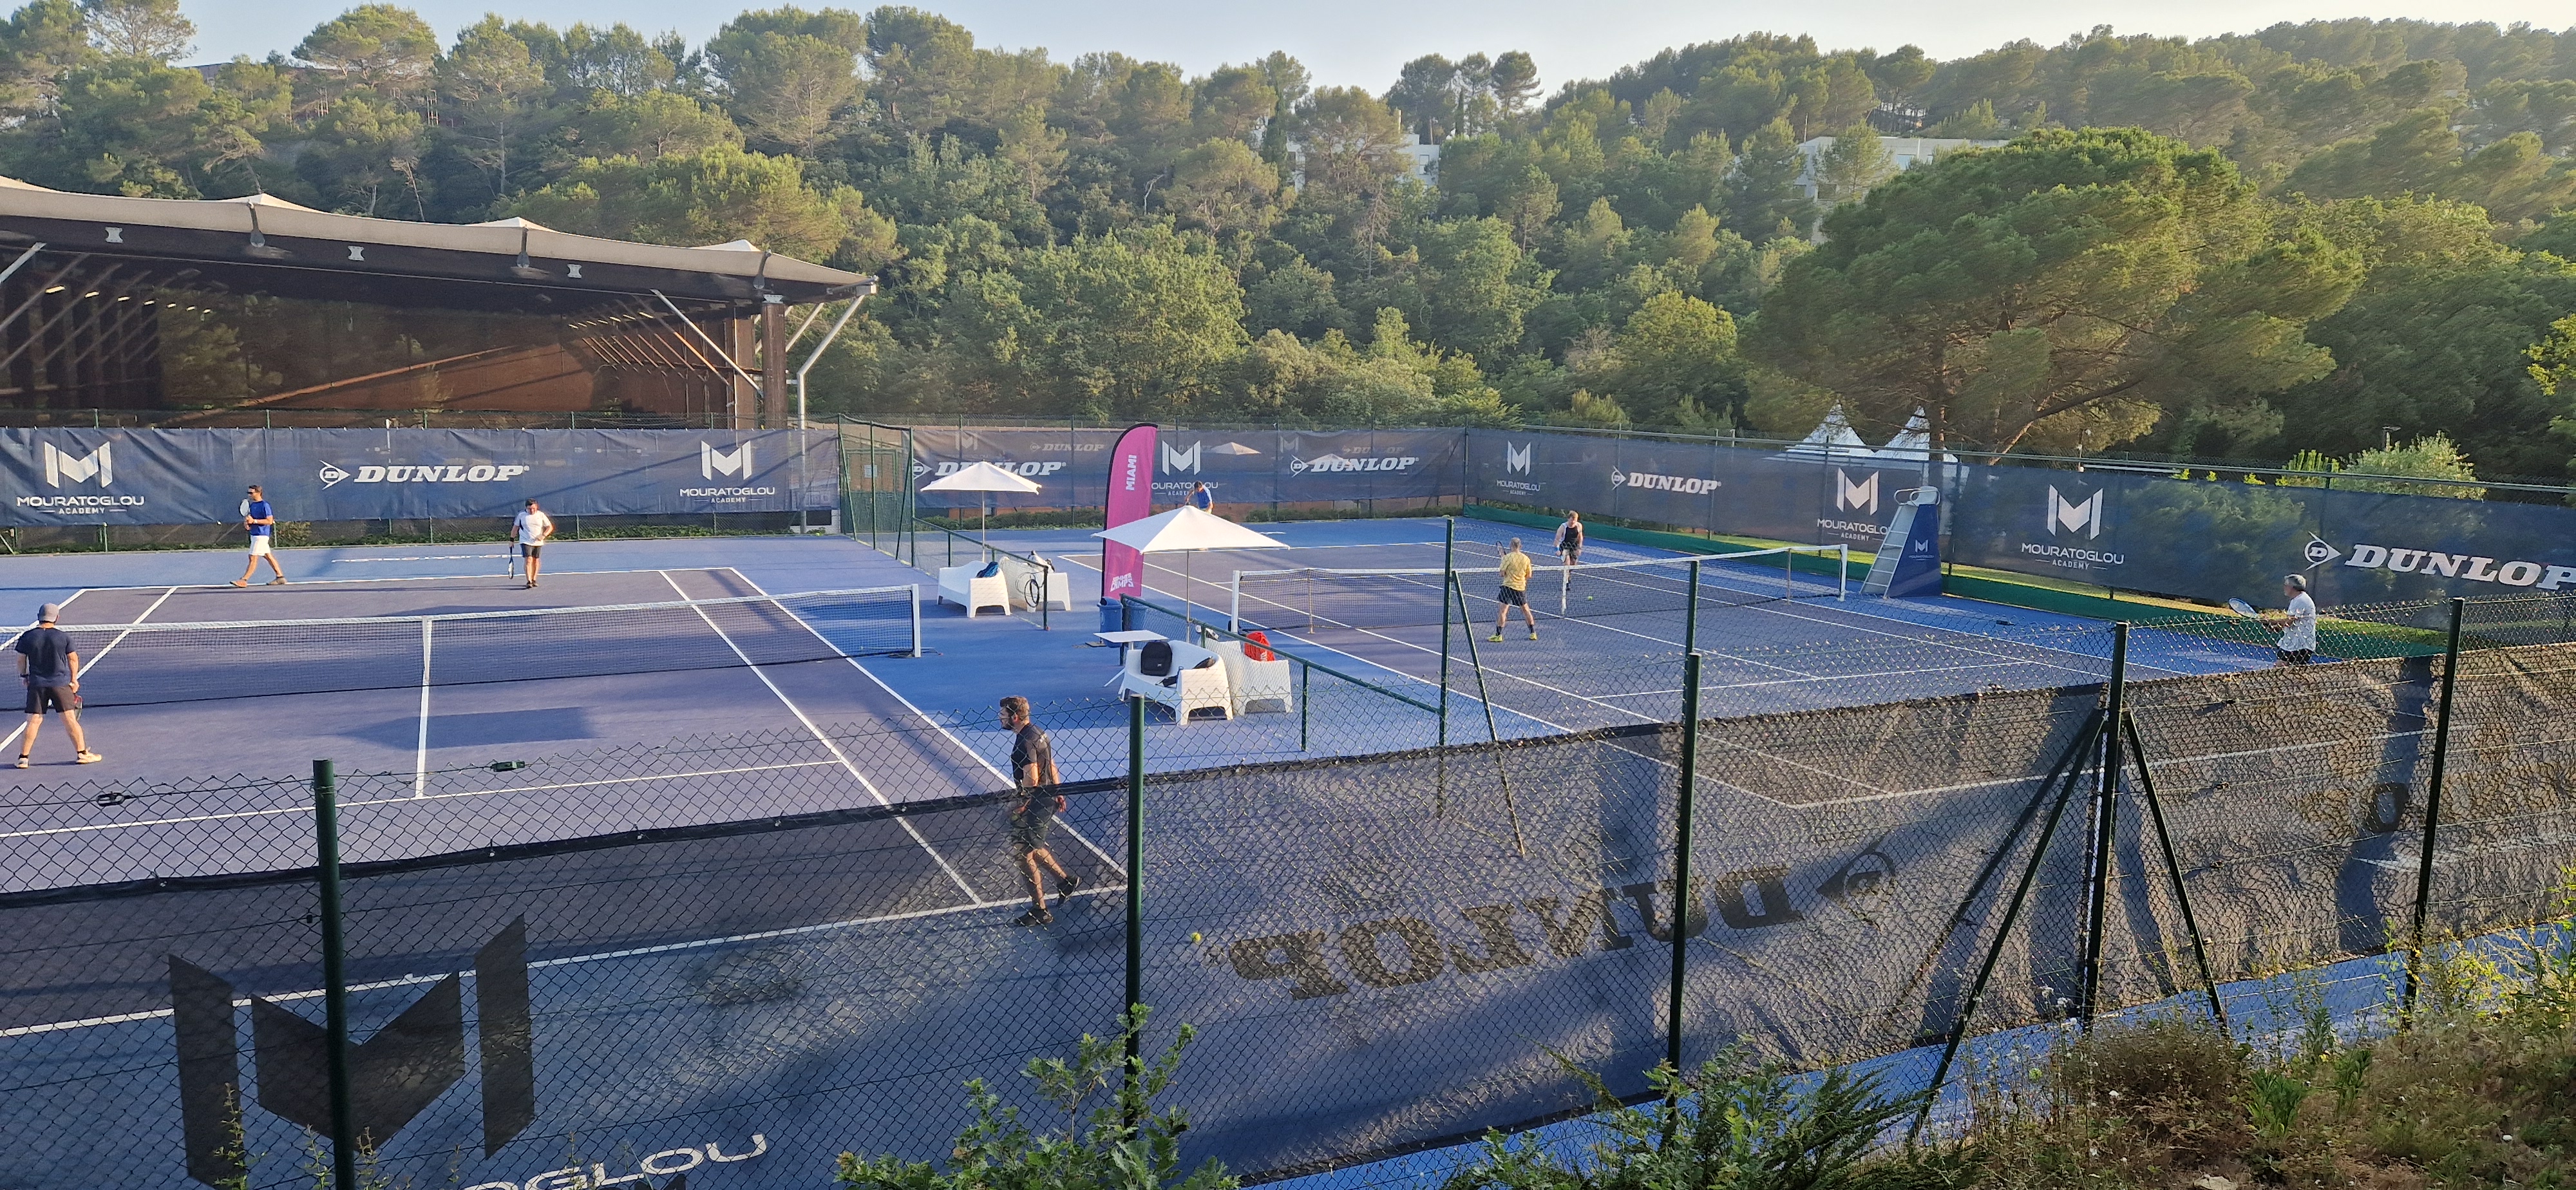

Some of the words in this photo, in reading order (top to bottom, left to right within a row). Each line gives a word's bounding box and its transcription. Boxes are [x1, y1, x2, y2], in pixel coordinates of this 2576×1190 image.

[1311, 457, 1416, 472] DUNLOP
[354, 466, 525, 482] DUNLOP
[1126, 455, 1137, 491] MIAMI
[1496, 480, 1540, 491] MOURATOGLOU
[1627, 472, 1719, 495] DUNLOP
[679, 487, 775, 497] MOURATOGLOU
[17, 496, 145, 506] MOURATOGLOU
[1817, 518, 1891, 535] MOURATOGLO
[1841, 532, 1870, 542] ACADEMY
[2021, 543, 2125, 565] MOURATOGLOU
[2052, 559, 2090, 570] ACADEMY
[2344, 543, 2576, 590] DUNLOP
[1110, 579, 1134, 592] CAMPS
